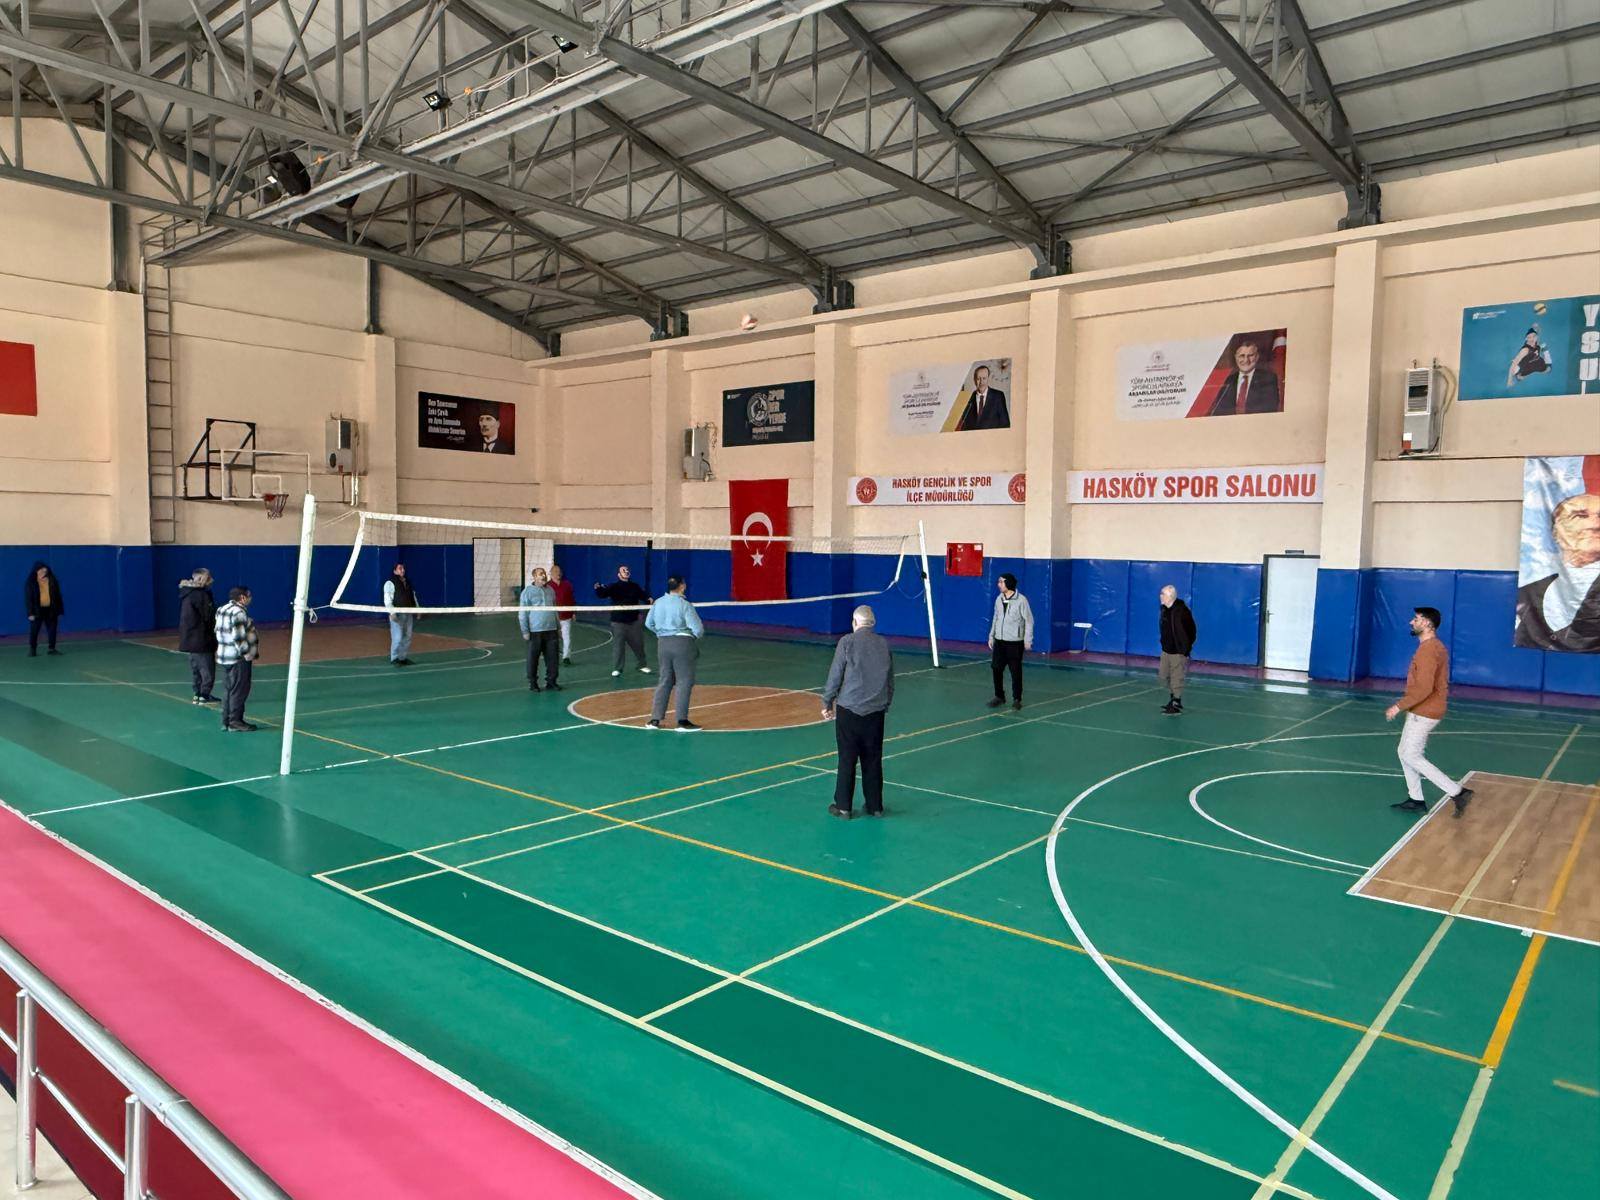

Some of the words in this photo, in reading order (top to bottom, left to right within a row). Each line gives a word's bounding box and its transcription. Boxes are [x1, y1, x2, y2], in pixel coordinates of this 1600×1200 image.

[1580, 358, 1600, 380] U
[892, 477, 921, 489] HASKÖY
[923, 476, 956, 489] GENÇLİK
[958, 475, 968, 487] VE
[970, 475, 992, 487] SPOR
[1083, 472, 1158, 498] HASKÖY
[1163, 475, 1218, 498] SPOR
[1225, 473, 1317, 498] SALONU
[906, 490, 923, 504] İLÇE
[925, 489, 974, 502] MÜDÜRLÜĞÜ
